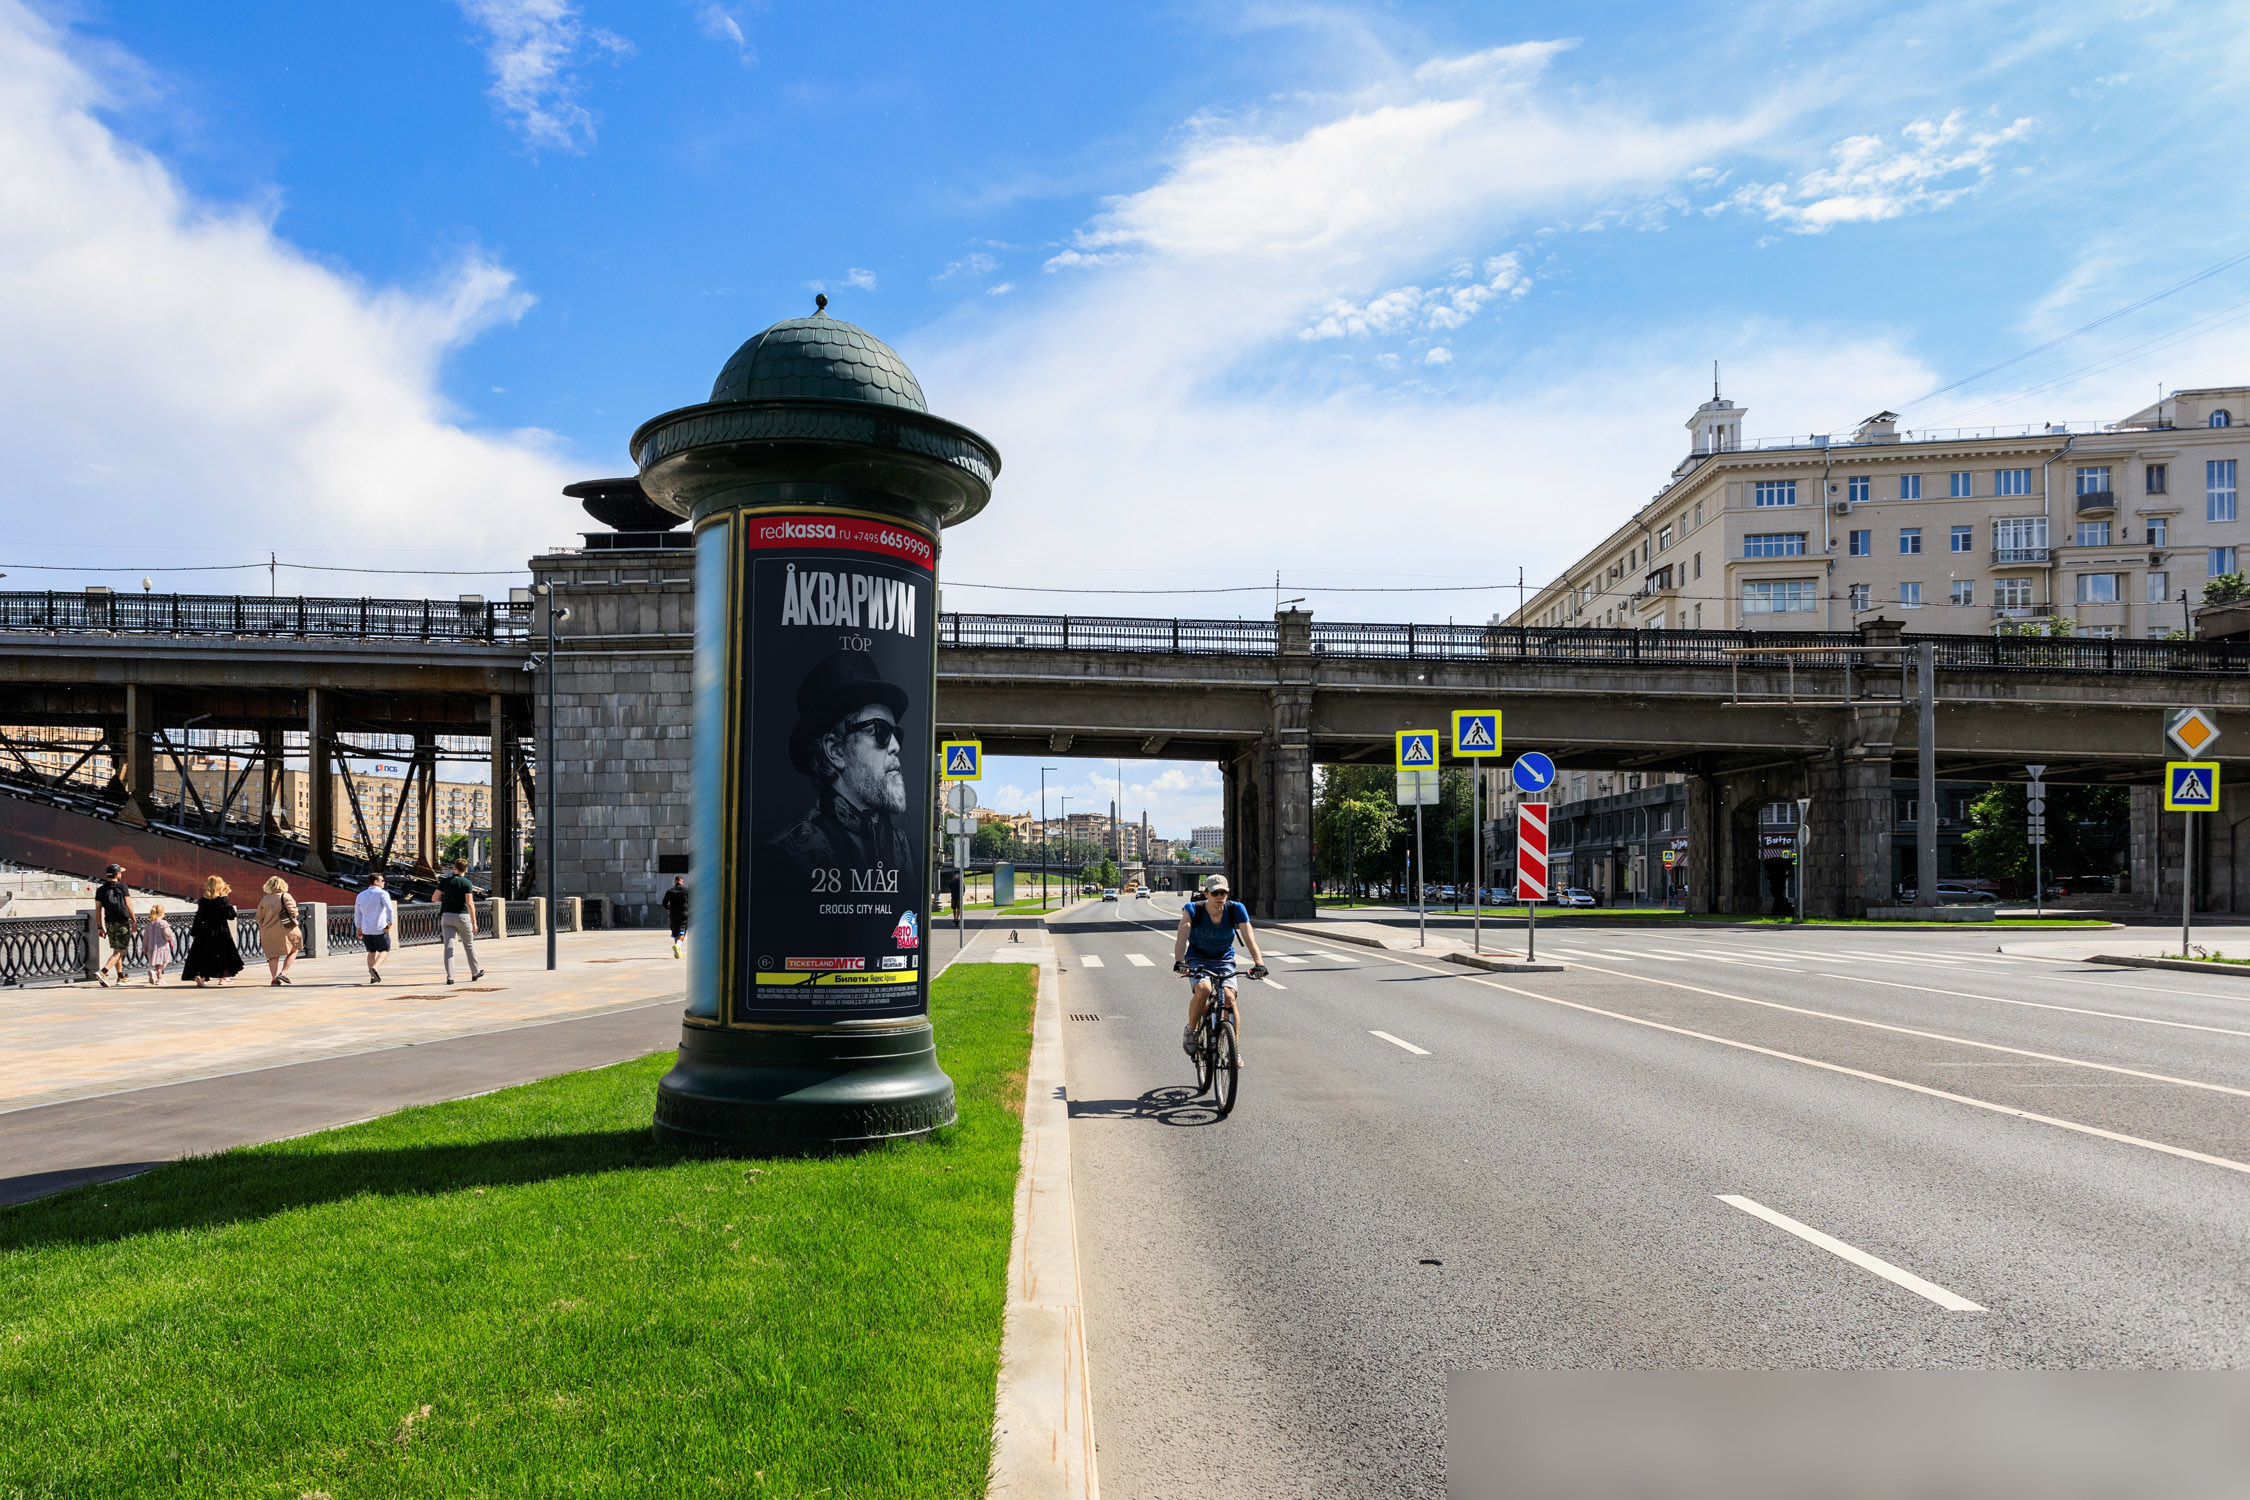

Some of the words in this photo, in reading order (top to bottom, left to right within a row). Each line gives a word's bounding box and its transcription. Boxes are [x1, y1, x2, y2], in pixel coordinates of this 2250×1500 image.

[760, 521, 851, 540] redkassa.ru
[811, 868, 842, 893] 28
[819, 904, 855, 914] CROCUS
[856, 904, 873, 914] CITY
[874, 904, 892, 915] HALL
[891, 926, 911, 938] АВТО
[897, 936, 919, 949] РАДИО
[835, 958, 864, 969] МТС
[835, 975, 868, 983] Билеты
